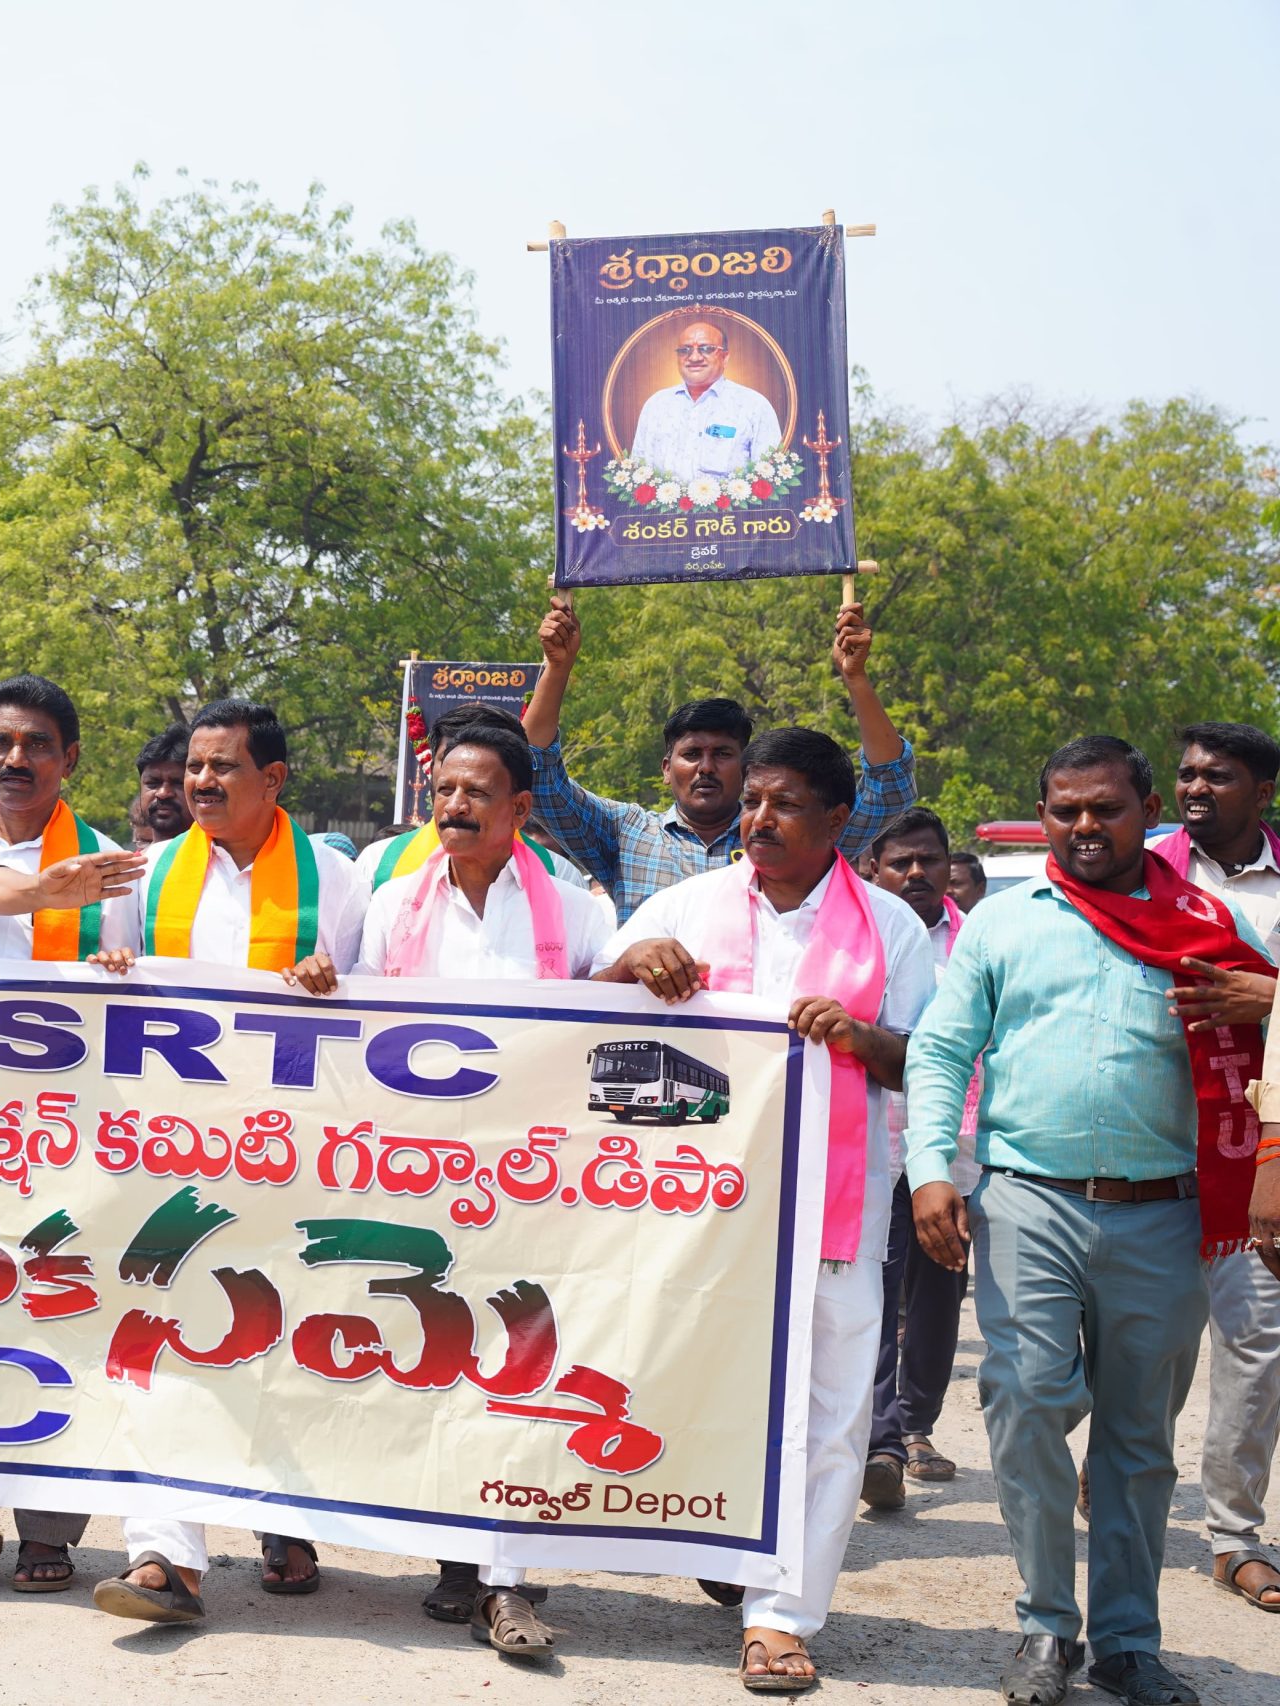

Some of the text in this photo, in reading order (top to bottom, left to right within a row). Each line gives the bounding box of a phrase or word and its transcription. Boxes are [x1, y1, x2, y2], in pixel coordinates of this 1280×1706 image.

[622, 515, 791, 540] శంకర్ గౌడ్ గారు
[603, 1043, 649, 1052] TGSRTC
[1194, 976, 1260, 1160] ITU
[94, 1109, 299, 1186] కమిటి
[103, 1186, 665, 1476] సమ్మె
[480, 1480, 727, 1522] గద్వాల్ Depot
